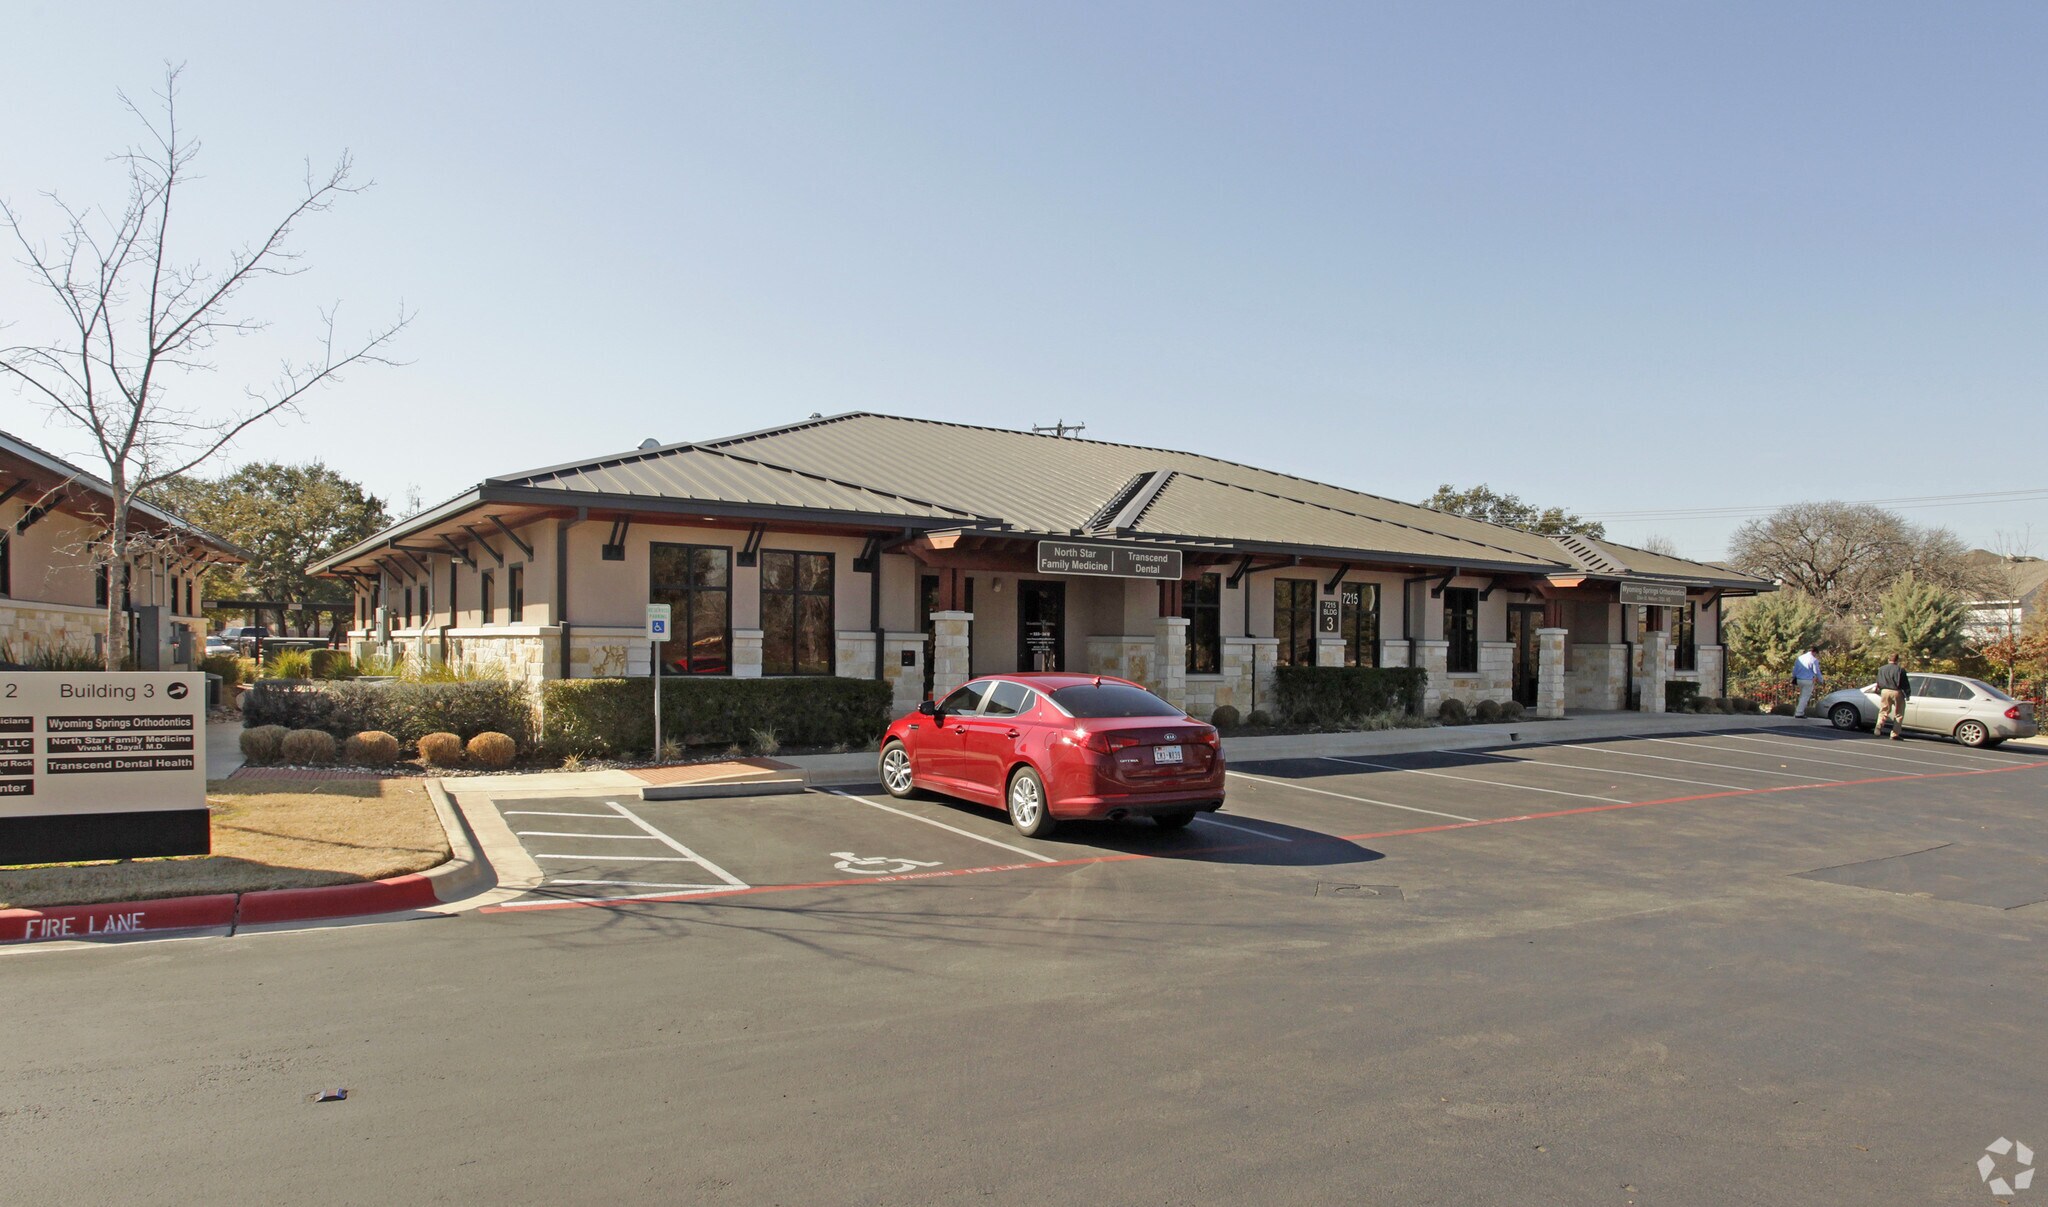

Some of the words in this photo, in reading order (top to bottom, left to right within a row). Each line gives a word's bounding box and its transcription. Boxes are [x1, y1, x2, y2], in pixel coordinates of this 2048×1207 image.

[1054, 547, 1078, 557] North
[1079, 548, 1096, 558] Star
[1128, 551, 1168, 563] Transcend
[1041, 559, 1070, 571] Family
[1071, 560, 1108, 571] Medicine
[1135, 563, 1160, 574] Dental
[1342, 592, 1359, 605] 7215
[1326, 616, 1334, 631] 3
[5, 683, 18, 698] 2
[60, 683, 136, 701] Building
[143, 683, 155, 698] 3
[48, 718, 94, 730] Wyoming
[95, 718, 131, 729] Springs
[133, 717, 191, 727] Orthodontics
[7, 740, 30, 748] LLC
[51, 737, 82, 745] North
[84, 736, 106, 744] Star
[108, 736, 143, 744] Family
[116, 744, 144, 752] Dayal,
[48, 760, 112, 770] Transcend
[115, 759, 153, 768] Dental
[155, 758, 192, 767] Health
[25, 917, 76, 940] FIRE
[88, 912, 145, 934] LANE
